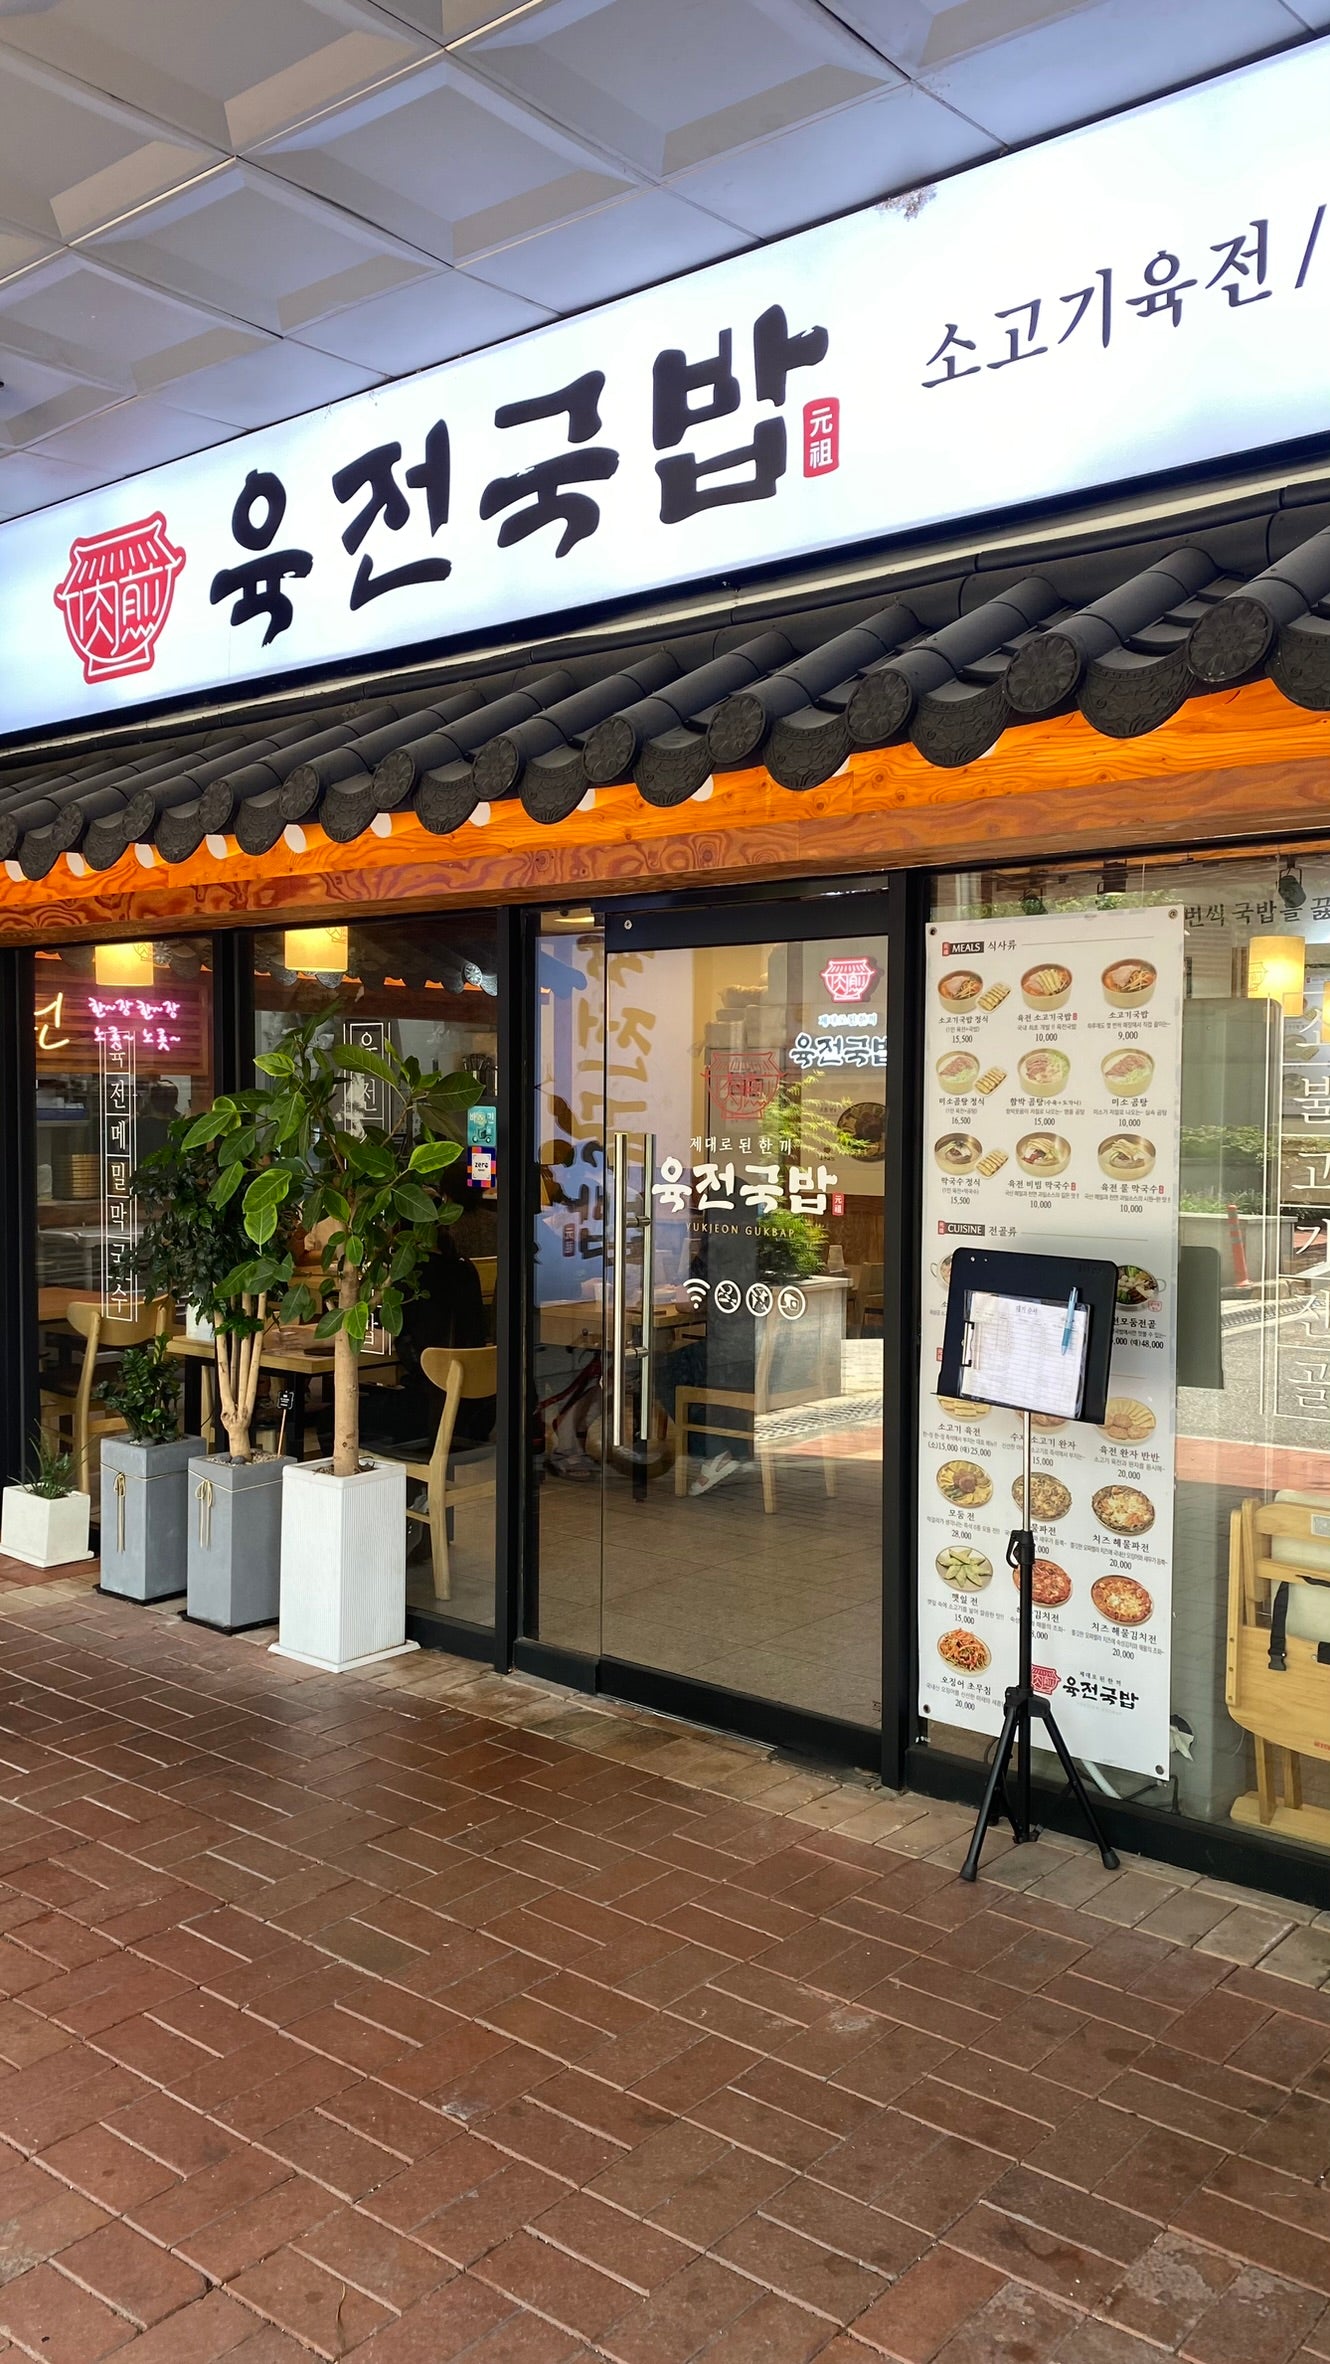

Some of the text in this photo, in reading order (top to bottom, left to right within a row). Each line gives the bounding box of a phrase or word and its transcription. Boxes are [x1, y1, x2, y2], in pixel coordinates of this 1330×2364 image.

[921, 219, 1273, 388] 소고기육전
[809, 406, 833, 469] 元祖
[210, 304, 829, 648] 육전국밥
[952, 942, 981, 953] MEALS
[988, 939, 1017, 951] 식사류
[938, 1015, 989, 1024] 소고기국밥 정식
[1017, 1013, 1031, 1022] 육전
[1034, 1012, 1071, 1021] 소고기국밥
[1108, 1010, 1149, 1019] 소고기국밥
[952, 1034, 973, 1044] 15,500
[1036, 1033, 1058, 1042] 10,000
[1118, 1031, 1139, 1041] 9,000
[970, 1097, 985, 1106] 정식
[1010, 1097, 1026, 1107] 함박
[1112, 1097, 1148, 1107] 미소 곰탕
[952, 1116, 971, 1125] 16,500
[1034, 1117, 1055, 1126] 15,000
[1119, 1118, 1141, 1127] 10,000
[689, 1136, 792, 1155] 제대로 된 한 끼
[651, 1156, 838, 1215] 육전국밥
[941, 1177, 981, 1187] 막국수 정식
[1008, 1180, 1024, 1189] 육전
[1026, 1180, 1042, 1190] 비빔
[1045, 1181, 1070, 1190] 막국수
[1101, 1183, 1117, 1192] 육전
[1120, 1184, 1129, 1193] 물
[1131, 1184, 1158, 1194] 막국수
[951, 1196, 971, 1205] 15,500
[1030, 1200, 1051, 1209] 10,000
[1120, 1204, 1143, 1214] 10,000
[686, 1222, 795, 1238] YUKJEON GUKBAP
[947, 1224, 982, 1235] CUISINE
[988, 1225, 1018, 1237] 전골류
[938, 1423, 981, 1437] 소고기 육전
[1031, 1436, 1056, 1447] 소고기
[1058, 1439, 1076, 1450] 완자
[1100, 1444, 1160, 1463] 육전 완자 반반
[1032, 1456, 1054, 1467] 15,000
[1117, 1469, 1141, 1480] 20,000
[967, 1512, 975, 1522] 전
[951, 1529, 972, 1540] 28,000
[1093, 1534, 1111, 1545] 치즈
[1113, 1538, 1150, 1553] 해물파전
[1109, 1558, 1132, 1570] 20,000
[952, 1593, 979, 1607] 깻잎 전
[955, 1613, 975, 1625] 15,000
[1091, 1621, 1109, 1632] 치즈
[1111, 1626, 1158, 1645] 해물김치전
[1112, 1647, 1135, 1660] 20,000
[941, 1676, 991, 1696] 오징어 초무침
[1062, 1676, 1139, 1710] 육전국밥
[955, 1699, 975, 1711] 20,000
